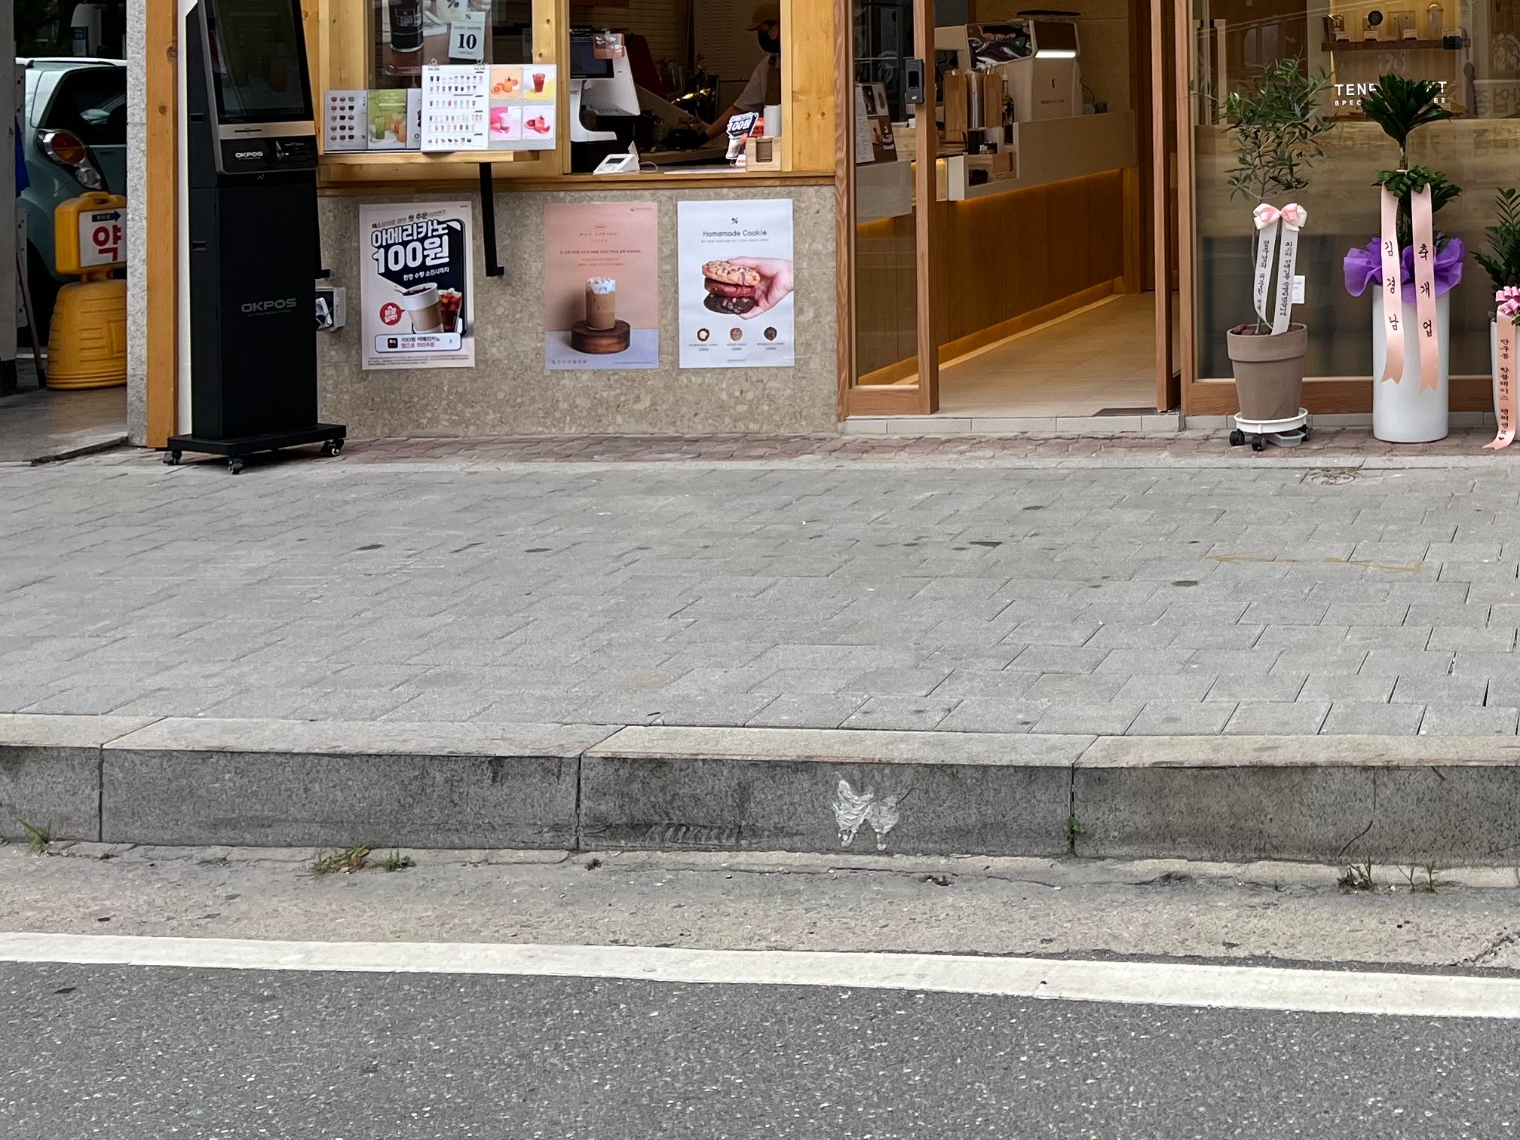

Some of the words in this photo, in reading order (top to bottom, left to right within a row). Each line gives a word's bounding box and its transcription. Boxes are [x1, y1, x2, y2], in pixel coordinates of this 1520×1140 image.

[458, 33, 477, 50] 10
[93, 224, 121, 262] 약
[371, 219, 449, 247] 아메리카노
[372, 234, 450, 274] 100원
[241, 298, 297, 313] OKPOS
